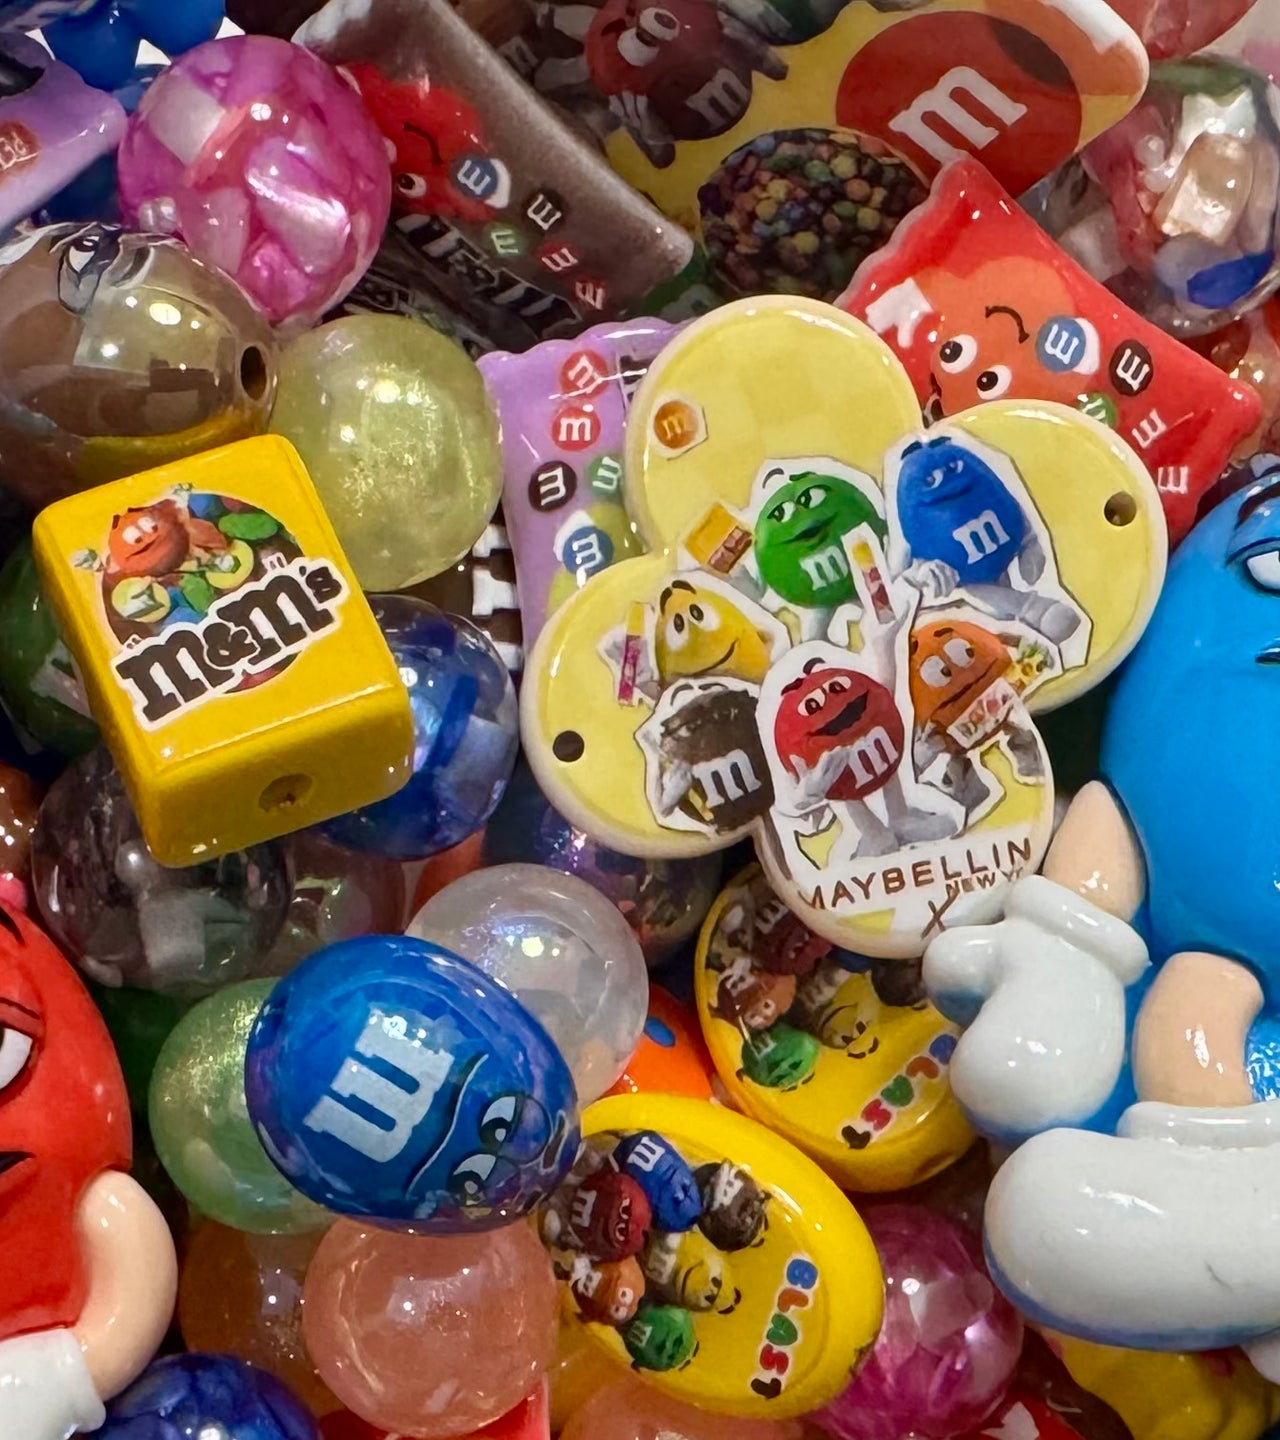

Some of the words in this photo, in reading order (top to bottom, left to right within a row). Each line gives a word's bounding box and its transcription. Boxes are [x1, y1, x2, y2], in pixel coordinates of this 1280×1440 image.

[686, 69, 750, 120] m
[888, 66, 1027, 165] m
[458, 159, 492, 195] m
[527, 194, 561, 231] m
[492, 229, 518, 254] m
[542, 247, 578, 272] m
[1045, 323, 1078, 359] m
[1119, 355, 1148, 387] m
[559, 417, 592, 442] m
[1132, 410, 1166, 448] m
[537, 466, 567, 507] m
[592, 456, 621, 491] m
[1158, 466, 1188, 494] m
[572, 533, 602, 571] m
[952, 509, 1011, 564] m
[799, 545, 851, 592] m
[116, 564, 342, 723] m&m's
[844, 726, 900, 788] m
[691, 748, 763, 808] m
[304, 1003, 455, 1163] m
[628, 1137, 665, 1172] m
[571, 1189, 597, 1227] m
[751, 1258, 818, 1400] BLAST
